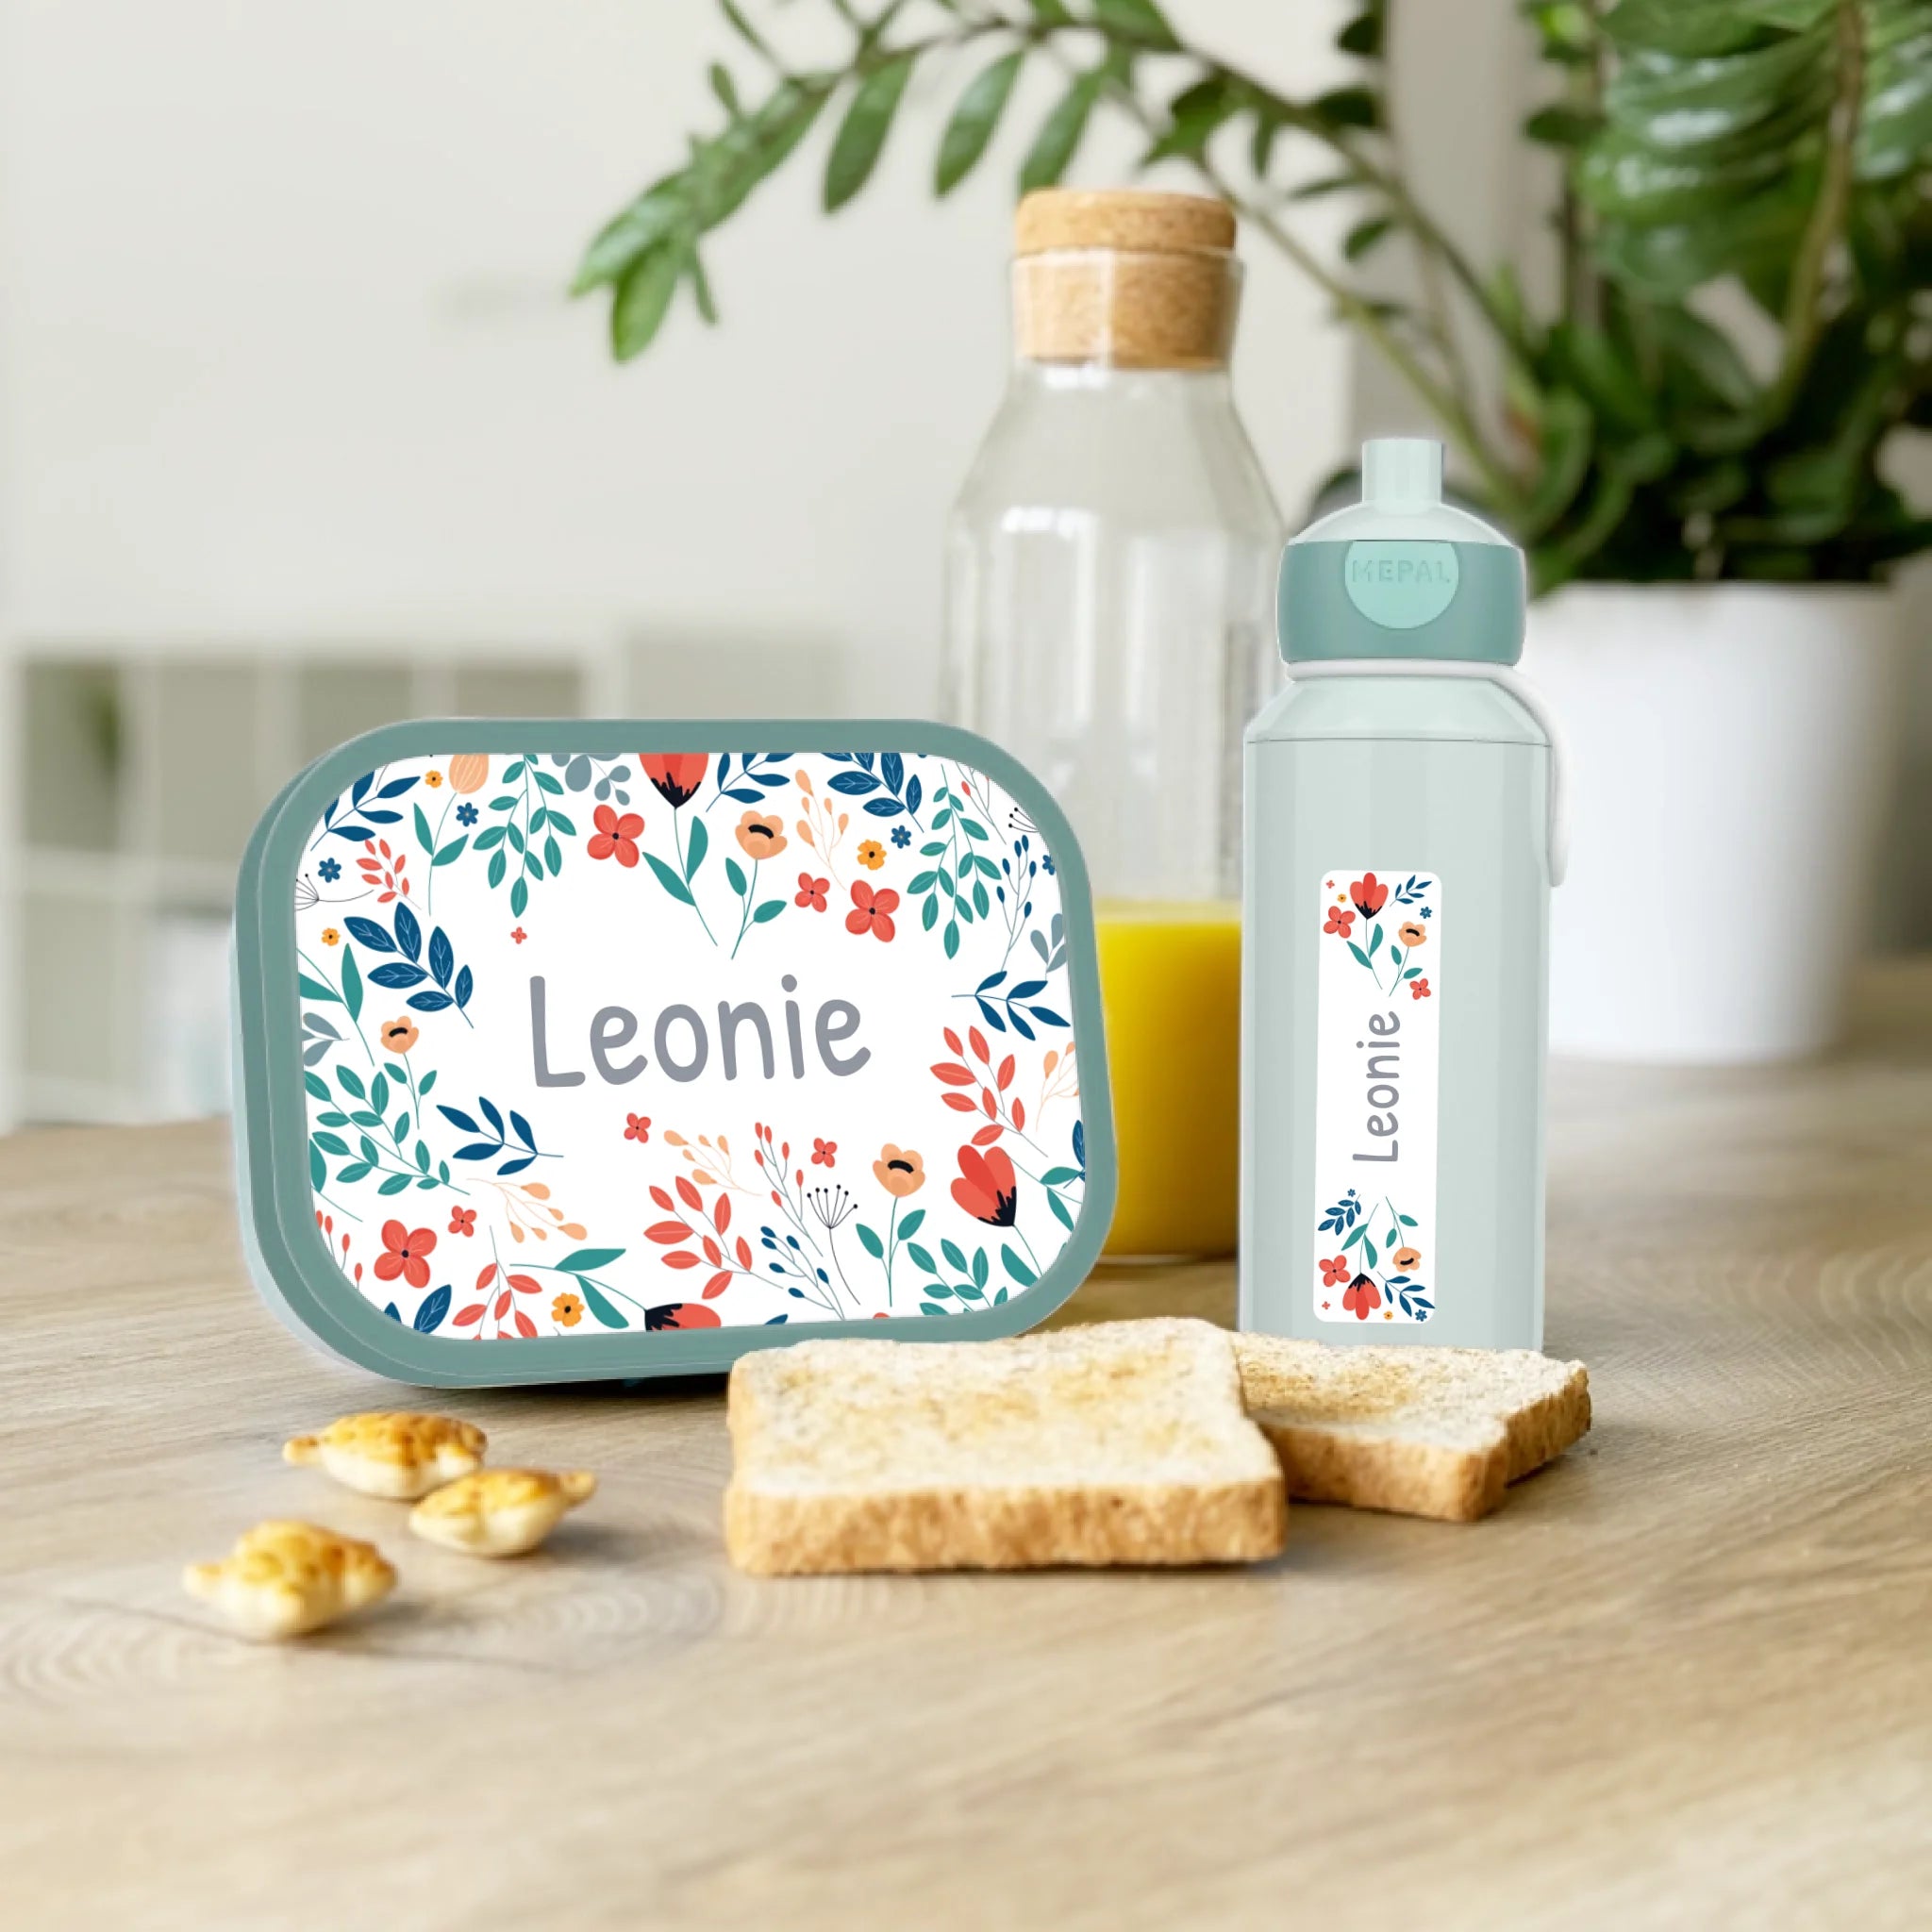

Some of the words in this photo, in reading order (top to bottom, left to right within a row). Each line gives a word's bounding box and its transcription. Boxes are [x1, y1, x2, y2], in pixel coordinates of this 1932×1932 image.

[1352, 559, 1451, 583] MEPAL
[529, 974, 872, 1089] Leonie
[1352, 1010, 1401, 1162] Leonie
